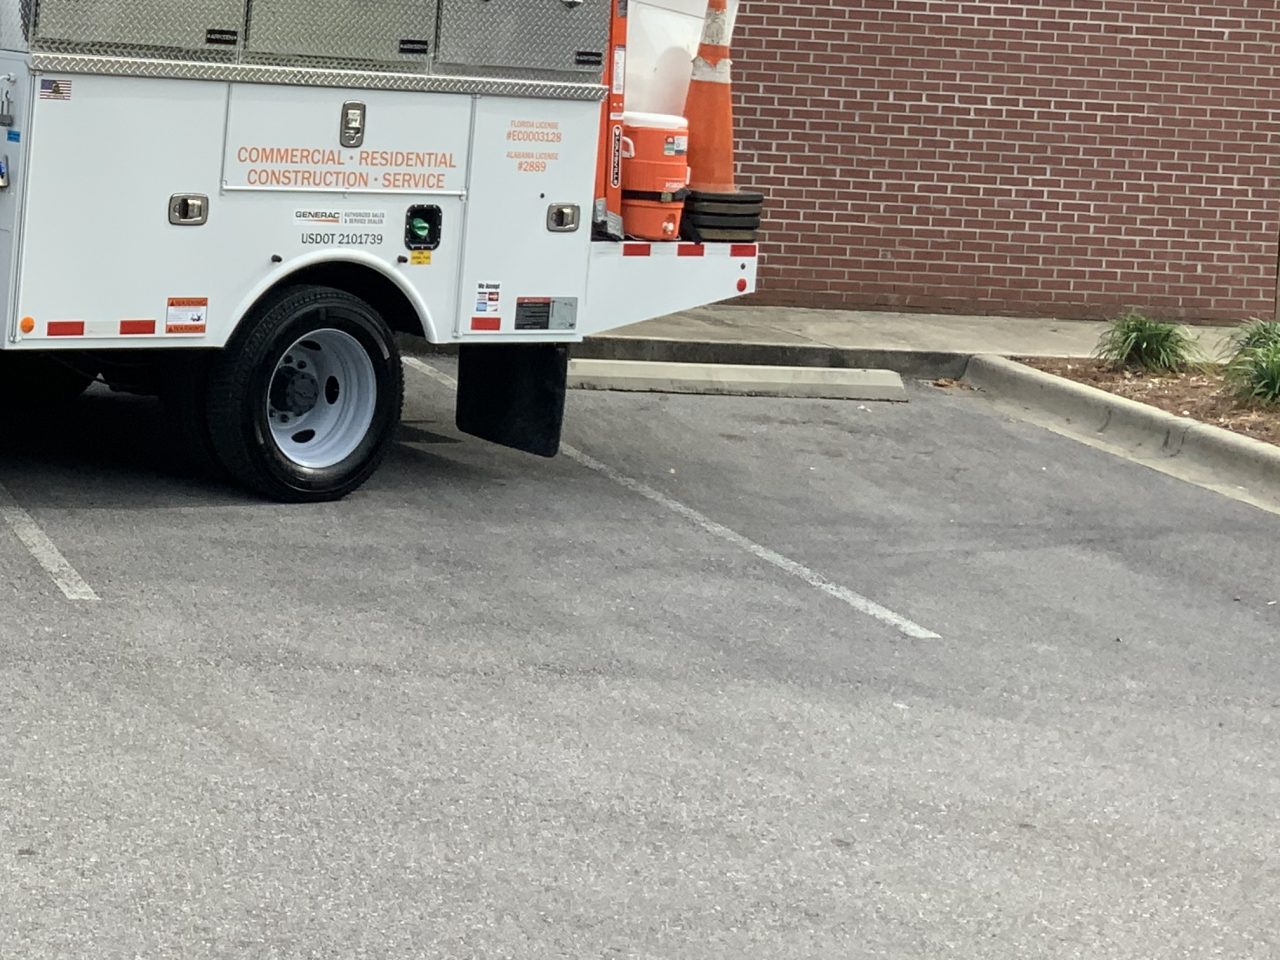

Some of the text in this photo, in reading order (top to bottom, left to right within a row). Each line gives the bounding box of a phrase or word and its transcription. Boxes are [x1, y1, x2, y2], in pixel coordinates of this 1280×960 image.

[511, 120, 534, 128] FLORIDA
[237, 146, 456, 168] COMMERCIAL RESIDENTIAL
[247, 169, 445, 188] CONSTRUCTION SERVICE
[295, 211, 340, 219] GENERAC
[301, 233, 384, 245] USDOT 2101739
